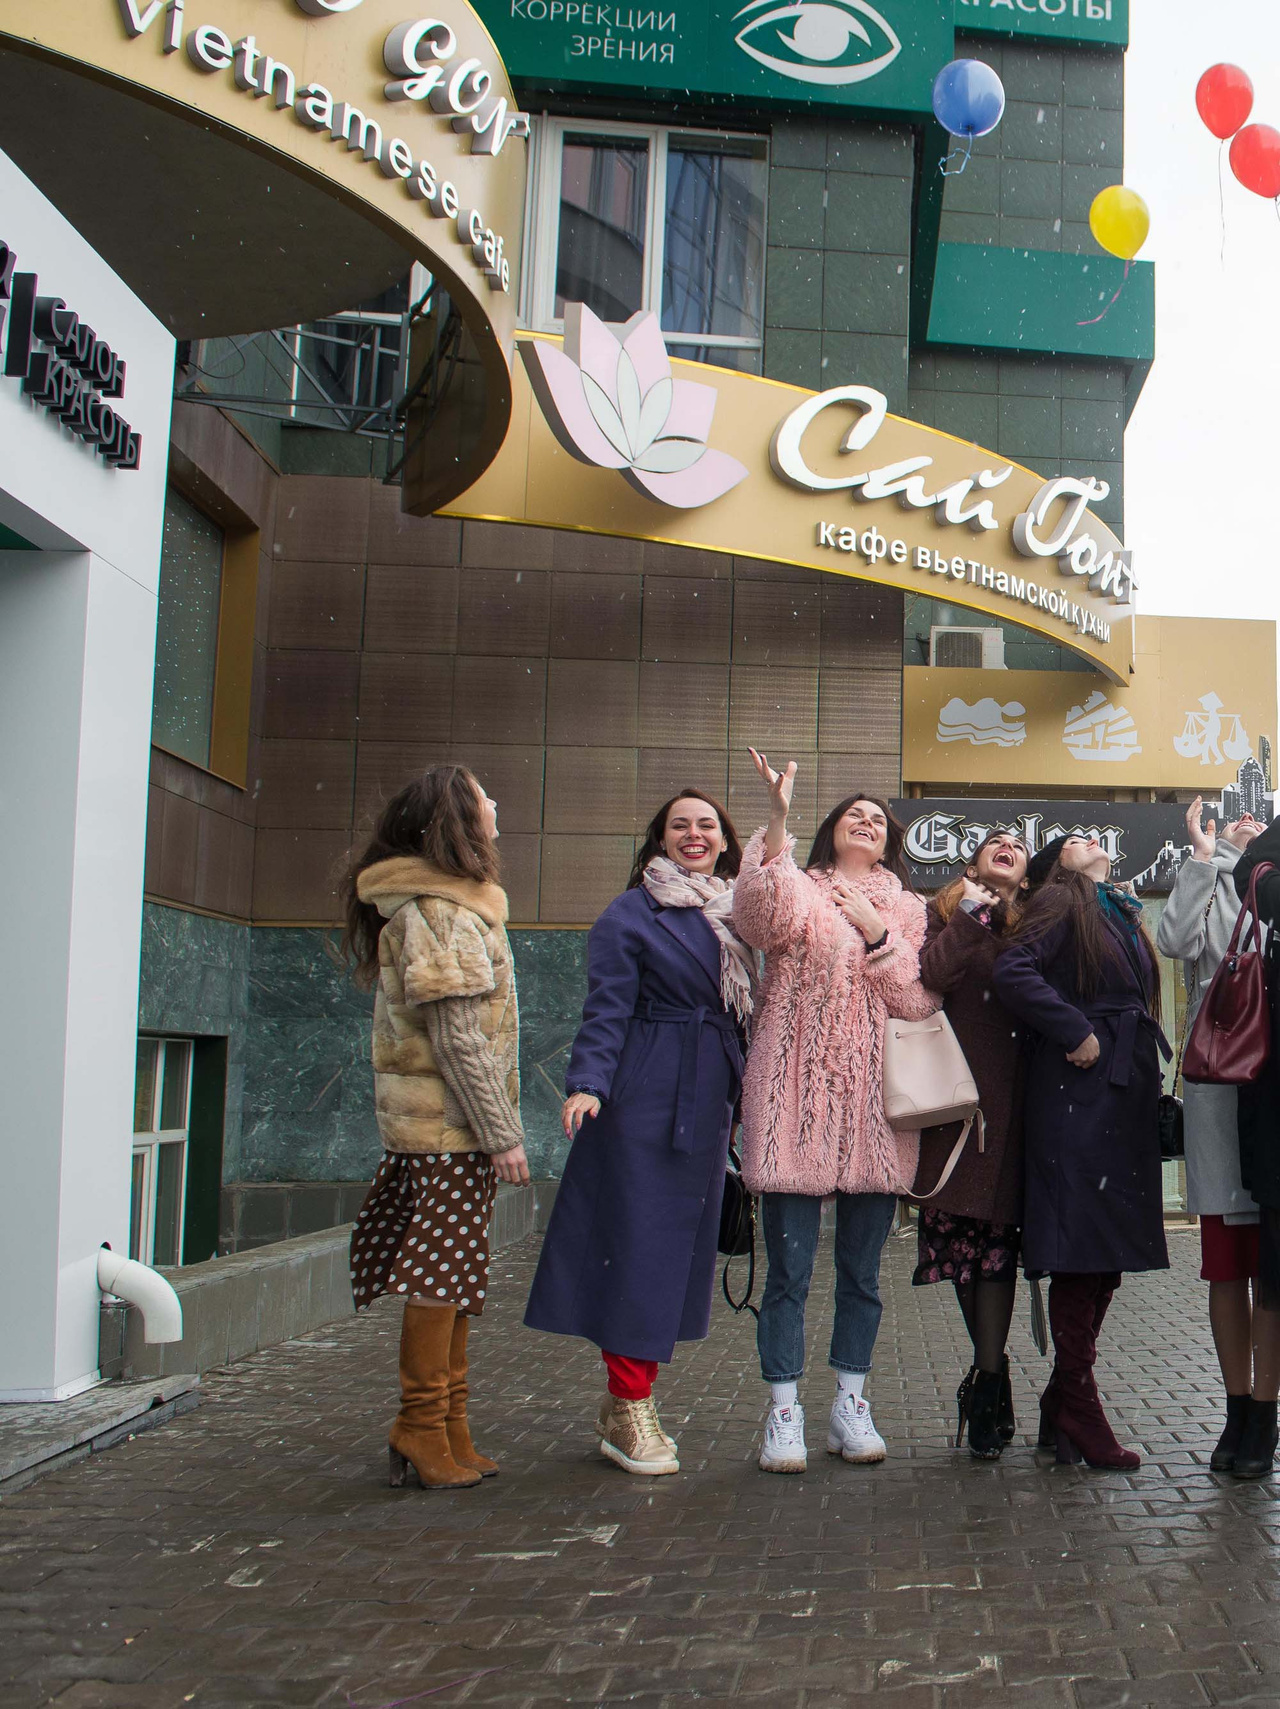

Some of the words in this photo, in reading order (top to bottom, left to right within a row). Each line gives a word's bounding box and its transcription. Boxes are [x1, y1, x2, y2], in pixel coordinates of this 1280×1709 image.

[511, 0, 676, 33] КОРРЕКЦИИ
[571, 35, 675, 64] ЗРЕНИЯ
[116, 0, 459, 220] vietnamese
[457, 208, 510, 292] cafe
[33, 296, 127, 398] САЛОН
[770, 385, 1013, 531] Сай
[815, 520, 908, 565] кафе
[912, 545, 1068, 620] вьетнамской
[1070, 602, 1112, 645] кухни
